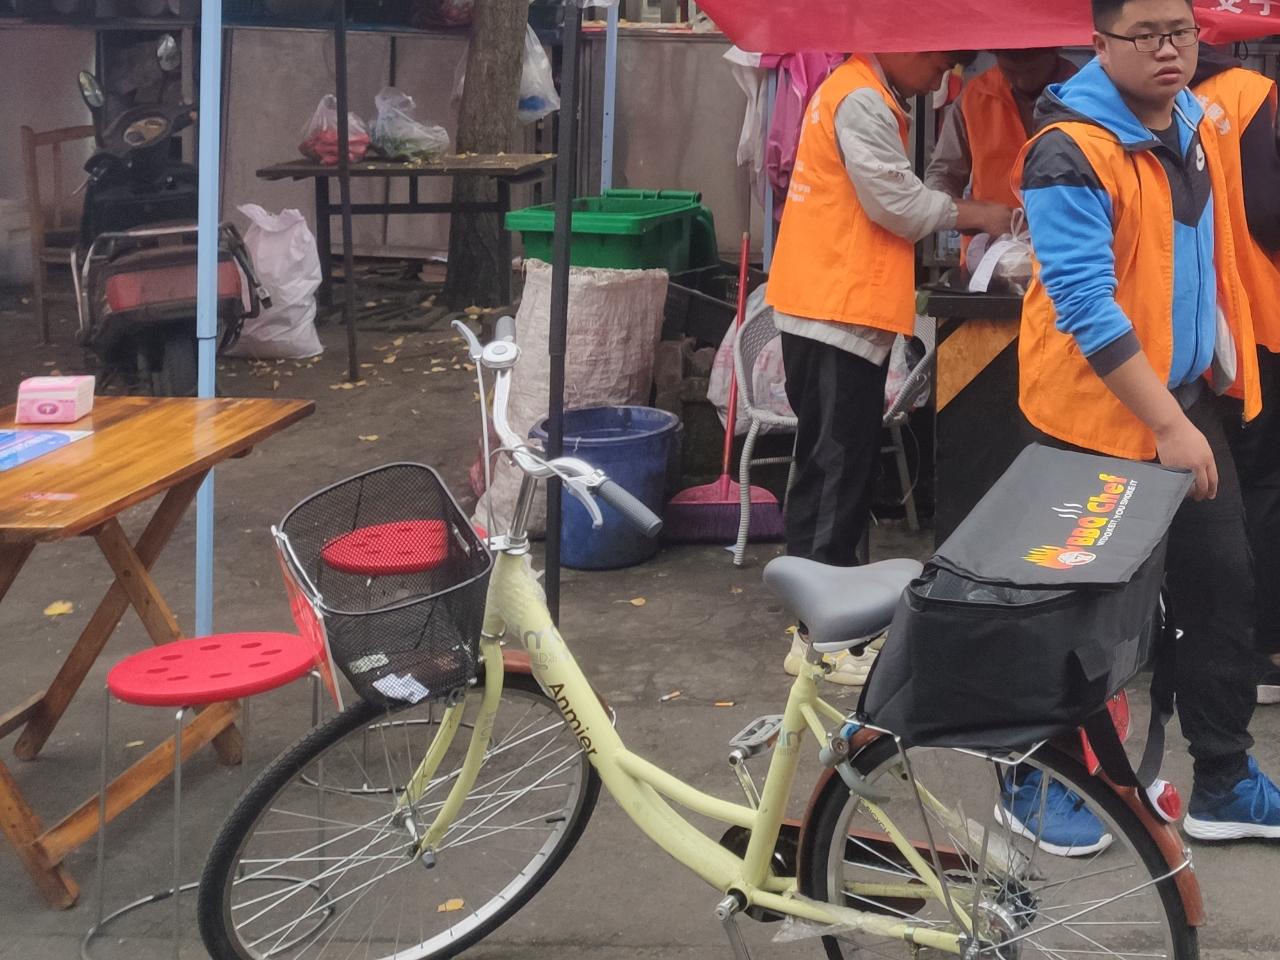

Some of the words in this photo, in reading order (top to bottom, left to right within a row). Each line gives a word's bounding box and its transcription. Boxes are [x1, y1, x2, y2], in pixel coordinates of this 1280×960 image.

[1065, 517, 1109, 546] BBQ
[1087, 473, 1128, 514] Chef
[549, 683, 598, 756] Anmier
